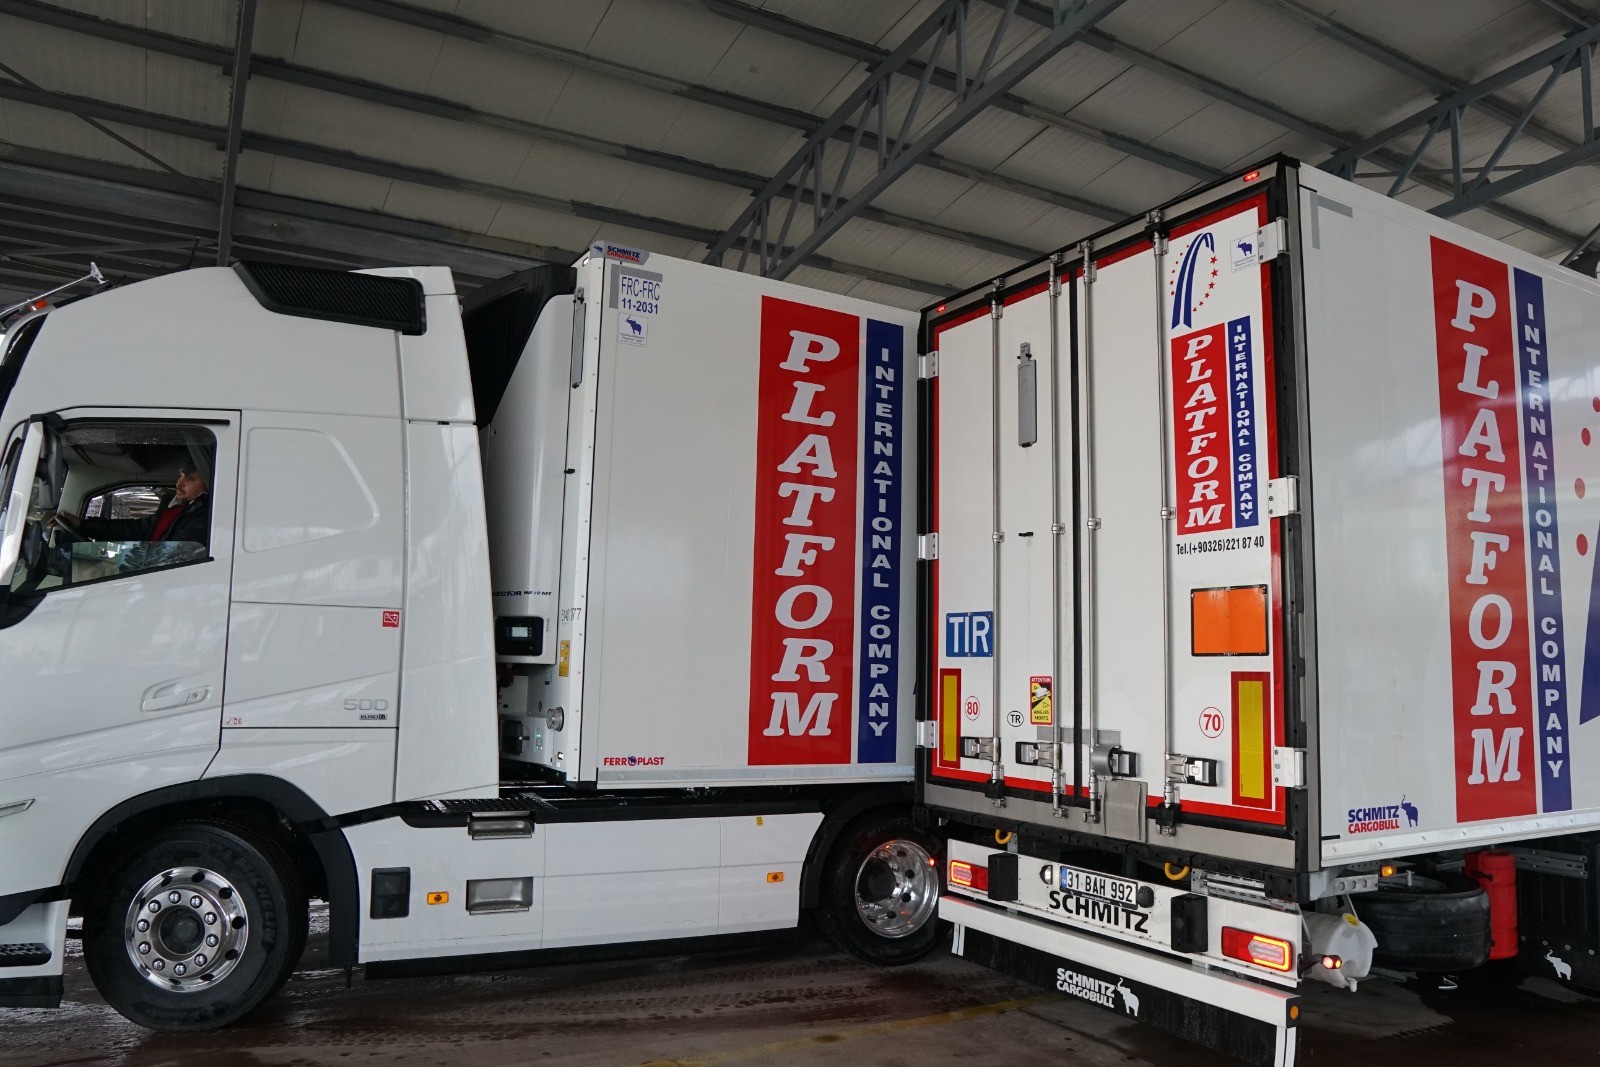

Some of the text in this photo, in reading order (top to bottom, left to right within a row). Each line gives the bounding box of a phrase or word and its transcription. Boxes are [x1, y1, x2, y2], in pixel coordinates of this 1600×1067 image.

[607, 245, 640, 258] SCHMITZ
[621, 276, 660, 301] FRC-FRC
[621, 298, 659, 315] 11-2031
[1183, 334, 1225, 528] PLATFORM
[1233, 324, 1253, 520] INTERNATIONAL COMPANY
[763, 329, 841, 737] PLATFORM
[868, 346, 895, 737] INTERNATIONAL COMPANY
[1242, 536, 1252, 549] 87
[1254, 535, 1265, 548] 40
[1450, 278, 1524, 786] PLATFORM
[1523, 302, 1564, 779] INTERNATIONAL COMPANY
[949, 615, 990, 653] TIR
[343, 698, 388, 711] 500
[966, 701, 979, 716] 80
[1010, 714, 1021, 724] TR
[1203, 713, 1221, 732] 70
[1347, 804, 1400, 823] SCHMITZ
[1347, 818, 1400, 834] CARGOBULL
[1067, 871, 1080, 890] 31
[1085, 875, 1106, 896] BAH
[1110, 881, 1133, 903] 992
[1049, 890, 1149, 934] SCHMITZ
[1056, 967, 1116, 998] SCHMITZ
[1056, 980, 1115, 1009] CARGOBULL
